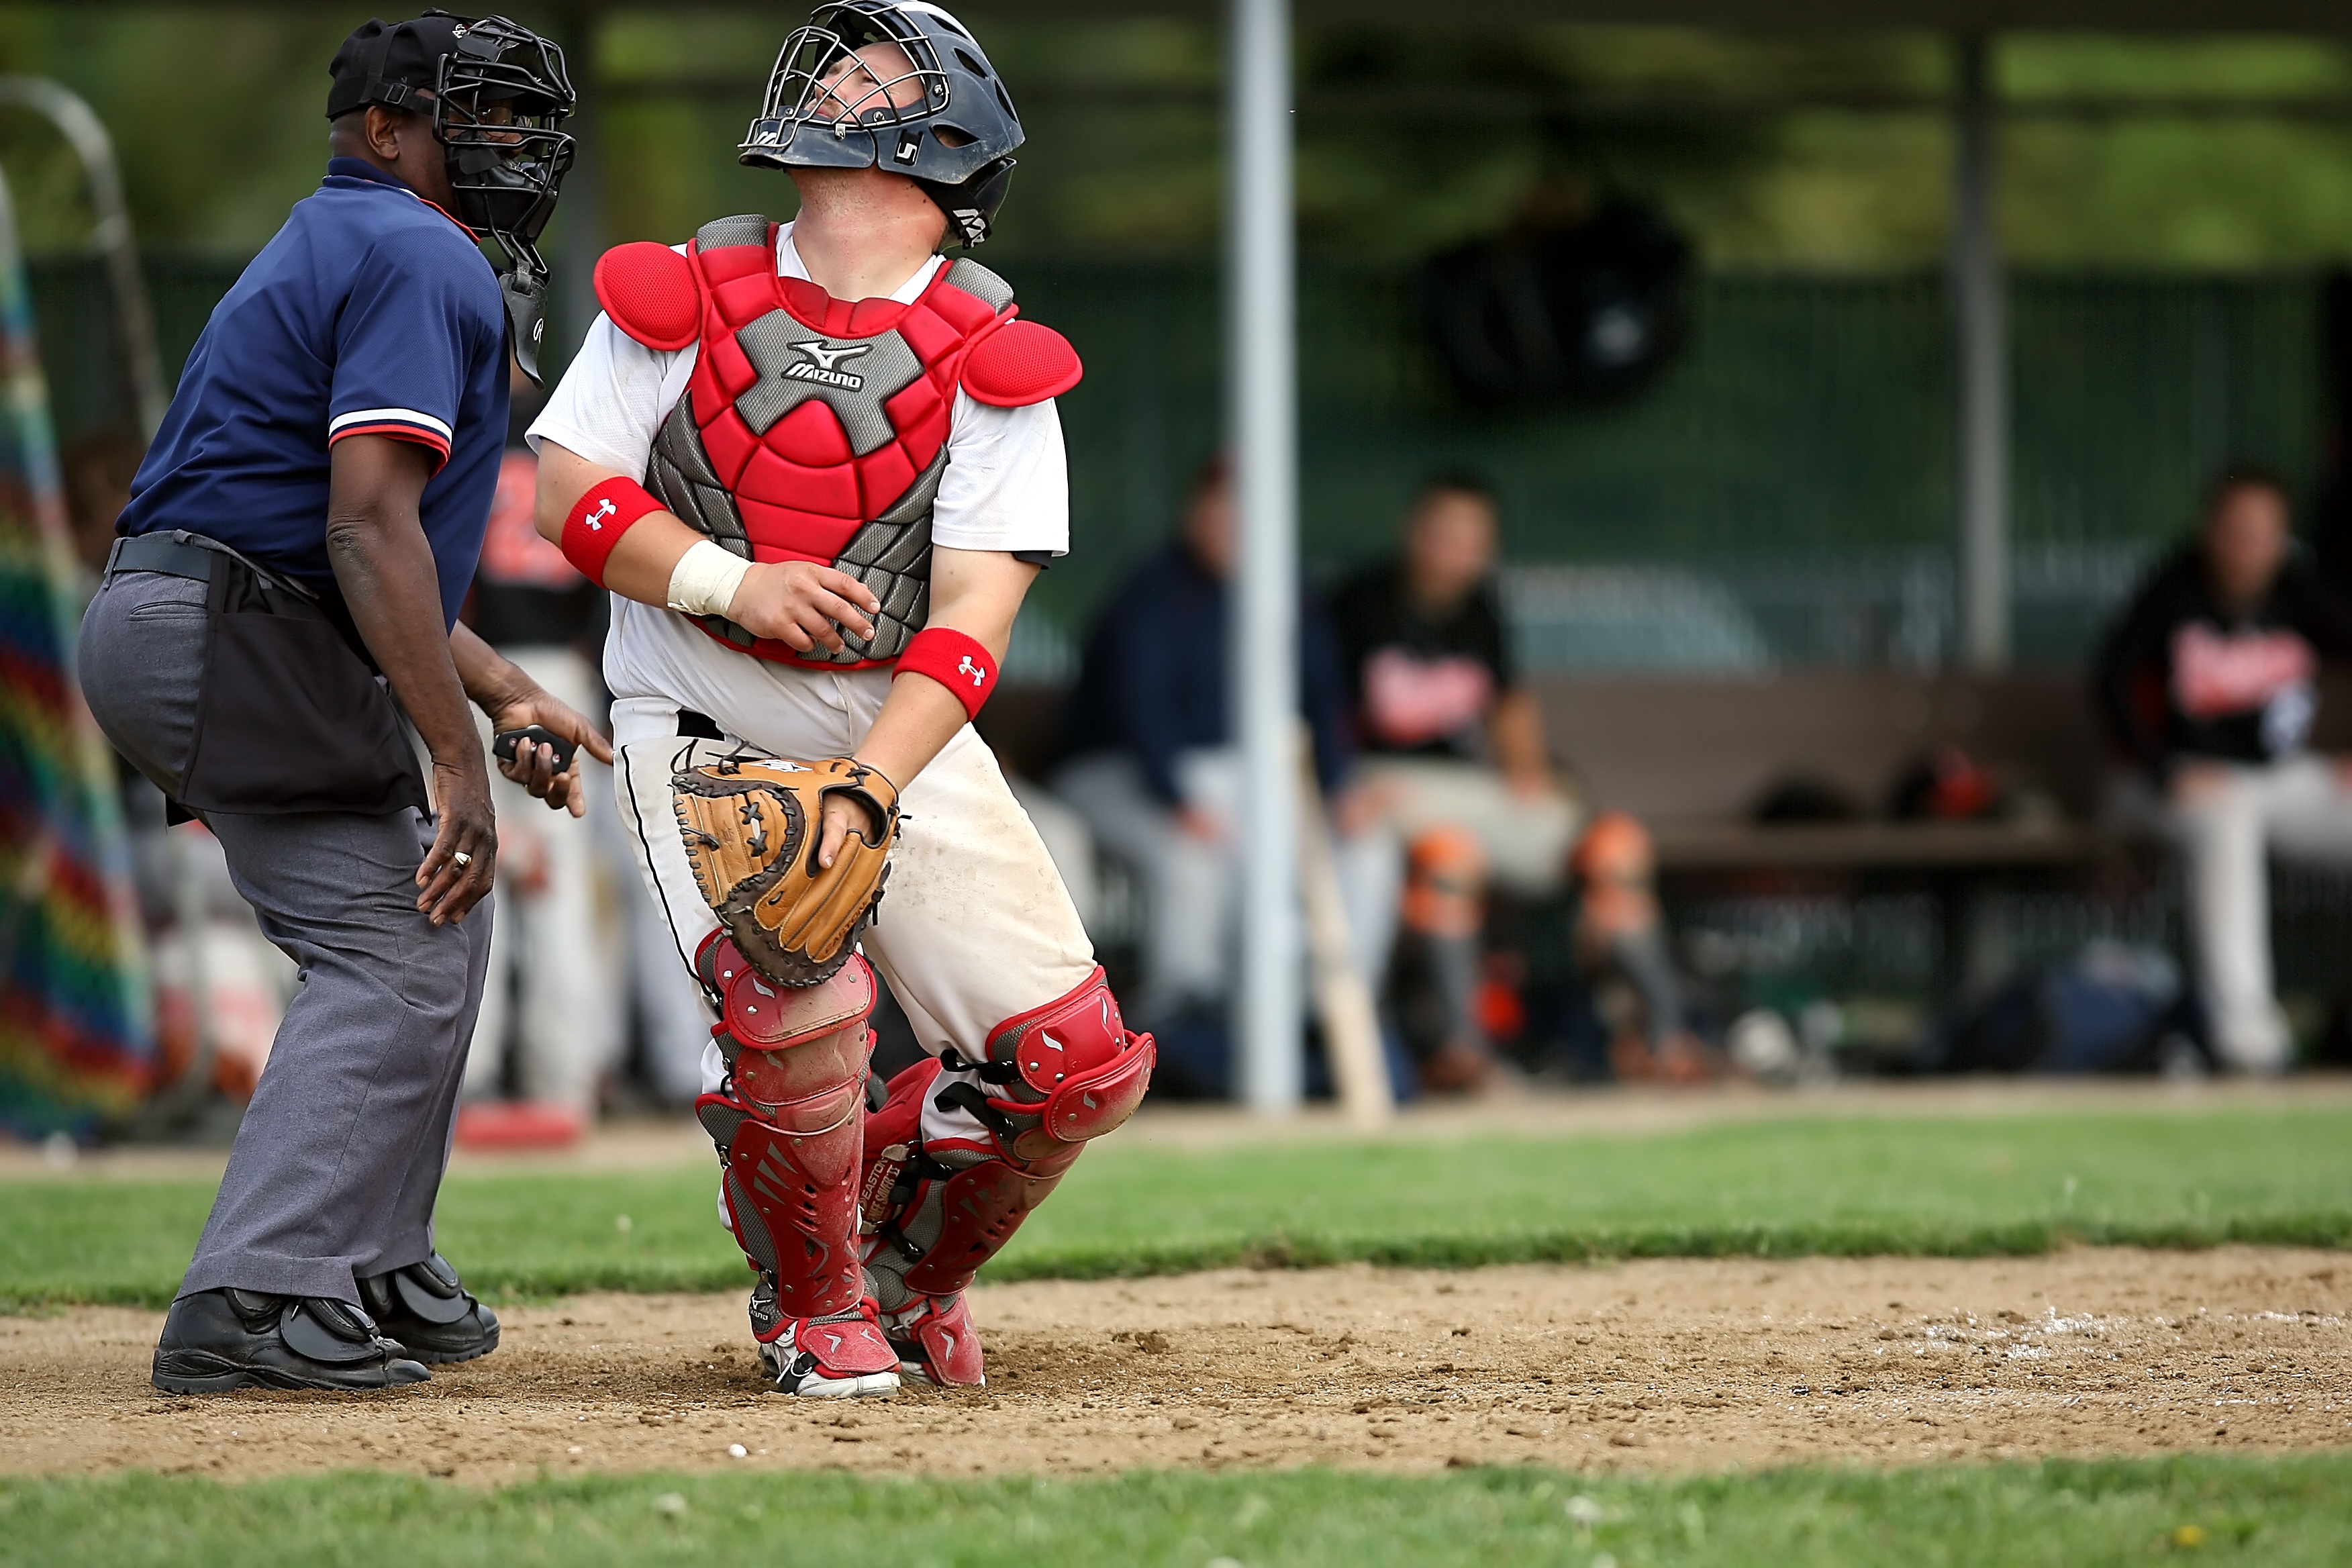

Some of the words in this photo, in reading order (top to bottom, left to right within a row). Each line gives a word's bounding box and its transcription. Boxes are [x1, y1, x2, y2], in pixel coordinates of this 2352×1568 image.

[786, 362, 861, 388] MIZUNO
[863, 1159, 889, 1201] EASTON
[875, 1174, 895, 1206] SAVER
